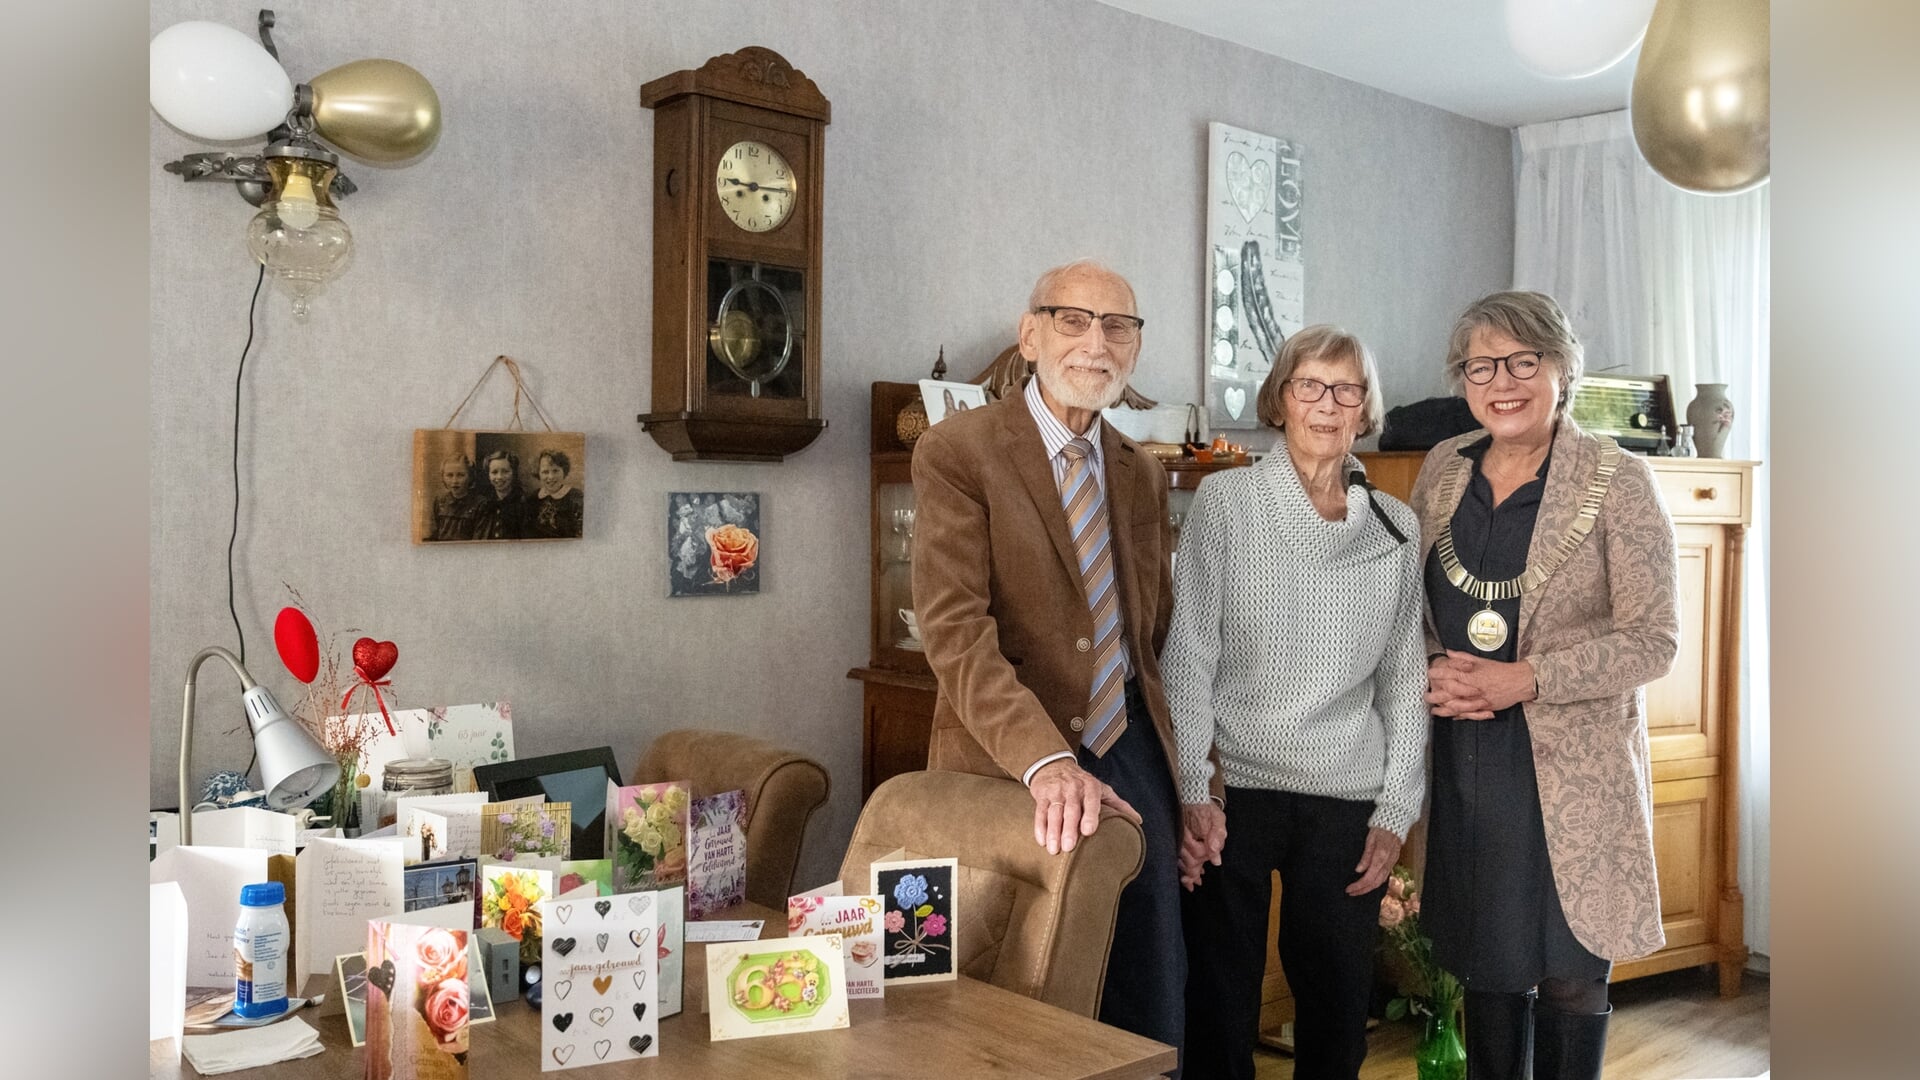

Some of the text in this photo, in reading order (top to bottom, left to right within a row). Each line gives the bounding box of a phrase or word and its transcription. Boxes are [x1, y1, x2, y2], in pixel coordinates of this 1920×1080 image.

[735, 148, 742, 160] 11
[748, 146, 760, 157] 12
[722, 159, 733, 170] 10
[767, 154, 771, 165] 1
[1278, 156, 1301, 254] LOVE
[716, 824, 731, 836] JAAR
[704, 845, 734, 861] VAN HARTE
[835, 907, 866, 924] JAAR
[596, 952, 641, 976] getrouwd
[857, 979, 873, 988] HARTE
[846, 987, 879, 995] ELICITEERD
